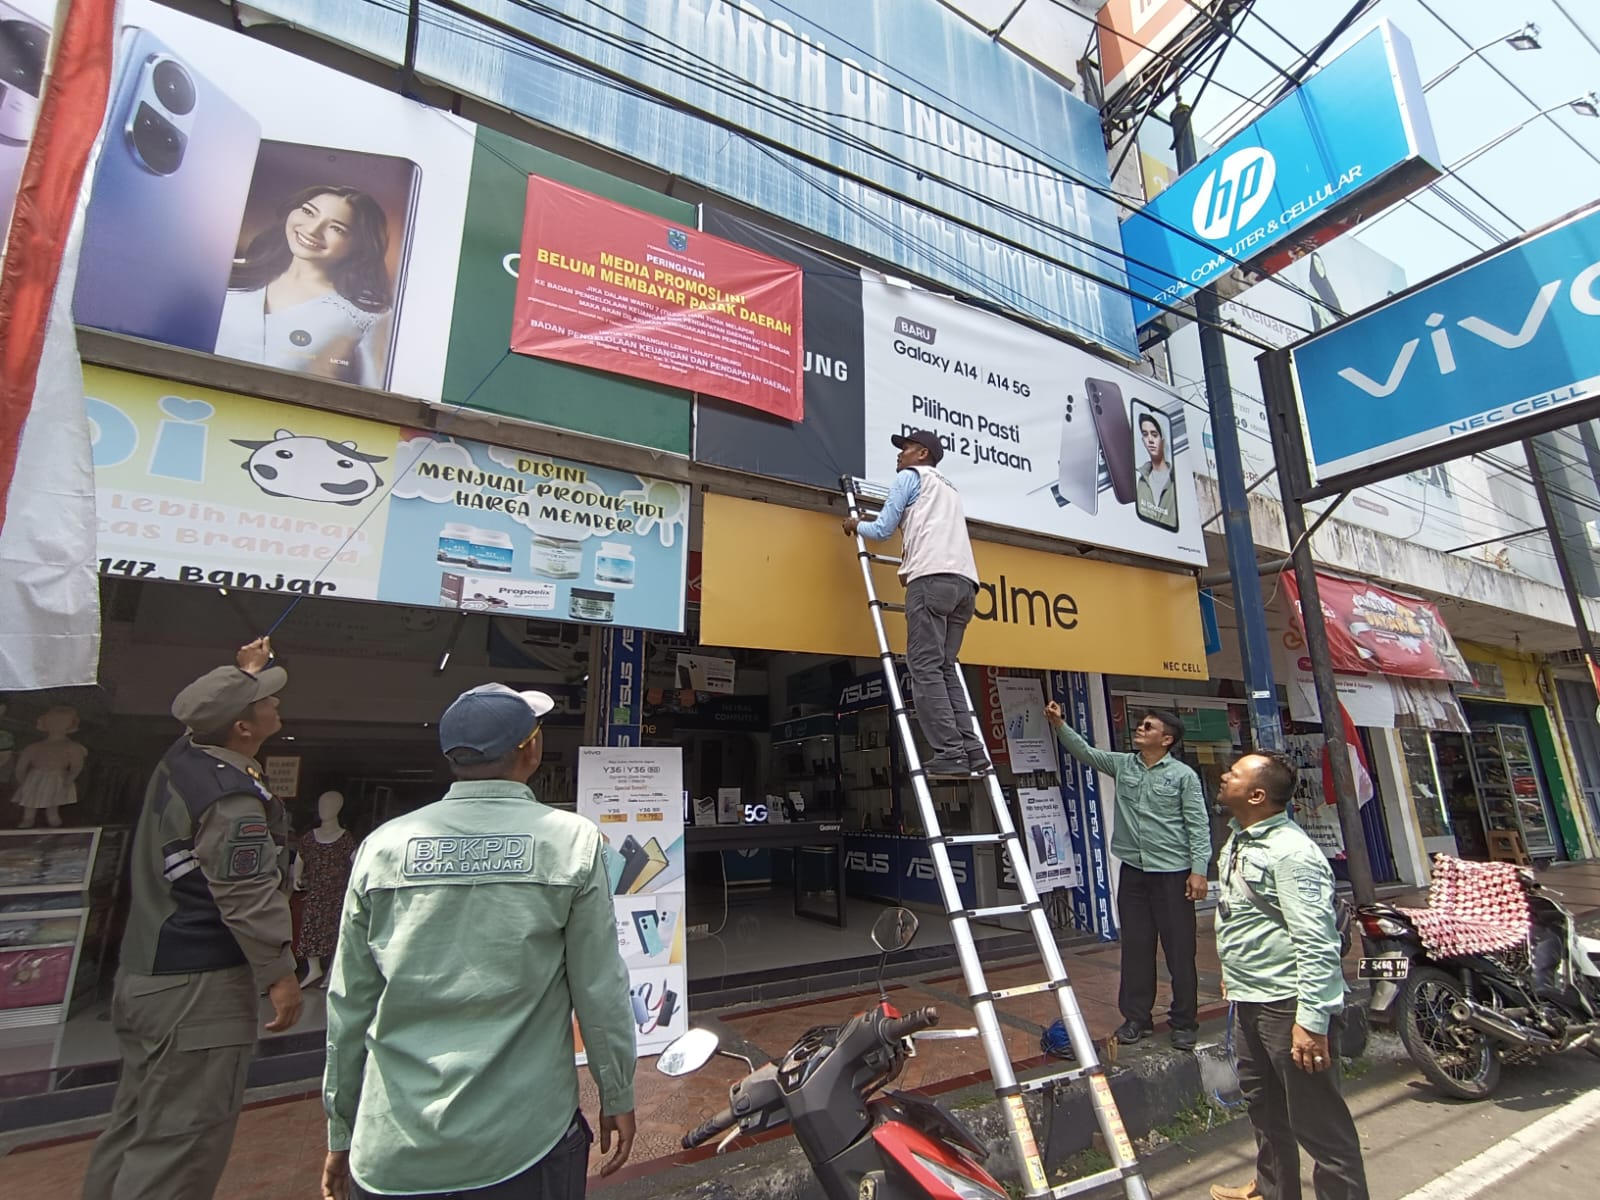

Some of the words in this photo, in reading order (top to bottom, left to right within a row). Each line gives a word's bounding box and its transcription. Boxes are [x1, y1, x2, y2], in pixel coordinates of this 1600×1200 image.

[1197, 151, 1270, 236] hp
[1191, 230, 1266, 281] COMPUTER
[1267, 220, 1279, 234] &
[1280, 164, 1362, 225] CELLULAR
[600, 252, 649, 279] MEDIA
[655, 269, 720, 302] PROMOSI
[646, 253, 705, 279] PERINGATAN
[537, 248, 595, 278] BELUM
[600, 268, 686, 306] MEMBAYAR
[690, 296, 736, 317] PAJAK
[740, 307, 792, 336] DAERAH
[547, 281, 573, 294] BADAN
[575, 289, 627, 310] PENGELOLAAN
[579, 299, 600, 311] MAKA
[602, 305, 621, 316] AKAN
[604, 288, 628, 302] DALAM
[630, 297, 654, 310] WAKTU
[900, 321, 932, 341] BARU
[530, 319, 565, 335] BADAN
[568, 328, 637, 349] PENGELOLAAN
[639, 343, 689, 361] KEUANGAN
[690, 355, 709, 367] DAN
[710, 361, 762, 382] PENDAPATAN
[893, 339, 950, 374] Galaxy
[953, 360, 979, 382] A14
[987, 371, 1010, 393] A14
[1014, 379, 1031, 398] 5G
[912, 394, 973, 431] Pilihan
[978, 416, 1020, 444] Pasti
[1449, 410, 1505, 436] NEC
[1512, 386, 1588, 416] CELL
[901, 423, 955, 453] mai
[960, 436, 971, 456] 2
[972, 439, 1033, 474] jutaan
[517, 458, 588, 484] DISINI
[417, 461, 528, 496] MENJUAL
[537, 483, 627, 512] PRODUK
[632, 501, 666, 520] HDI
[455, 490, 530, 517] HARGA
[179, 565, 338, 596] Banjar
[976, 574, 1079, 631] alme
[1162, 661, 1180, 672] NEC
[1181, 662, 1202, 673] CELL
[839, 679, 882, 705] ASUS
[1078, 702, 1089, 740] ASUS
[1064, 753, 1075, 791] ASUS
[744, 804, 768, 822] 5G
[819, 824, 841, 832] Galaxy
[1068, 799, 1080, 839] ASUS
[1089, 800, 1101, 840] ASUS
[411, 861, 455, 873] KOTA
[460, 859, 524, 872] BANJAR
[414, 836, 526, 862] BPKPD
[844, 851, 890, 874] ASUS
[906, 857, 968, 884] ASS
[1095, 849, 1105, 889] ASUS
[1100, 898, 1112, 940] ASUS
